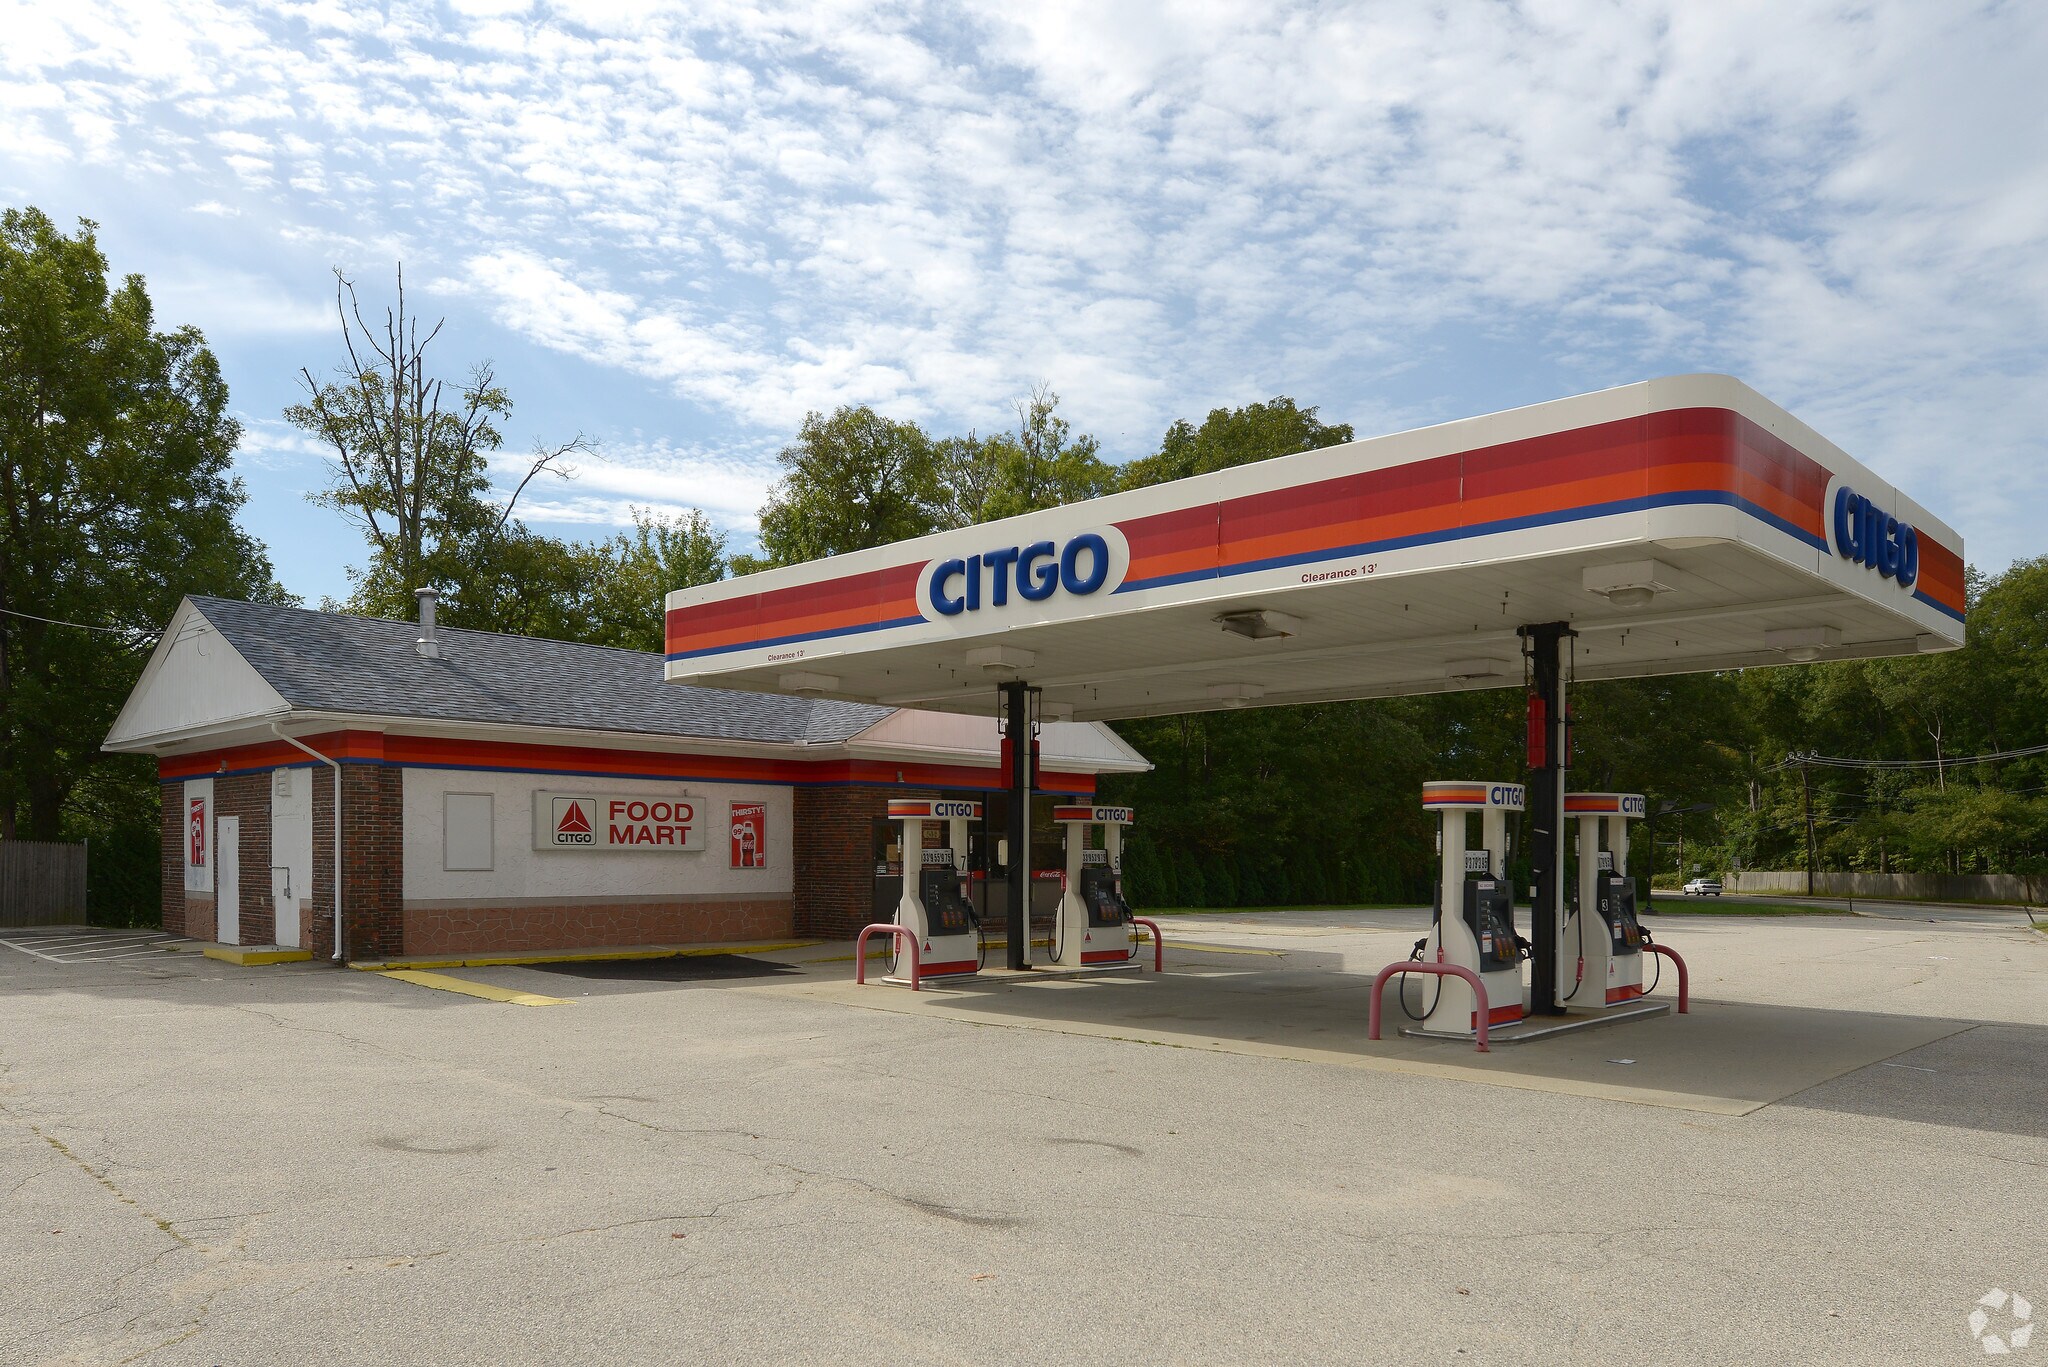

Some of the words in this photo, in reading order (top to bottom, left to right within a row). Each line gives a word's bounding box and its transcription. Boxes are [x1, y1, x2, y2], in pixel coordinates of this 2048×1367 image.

[1834, 485, 1918, 588] CITGO
[929, 533, 1109, 616] CITGO
[1301, 568, 1357, 583] Clearance
[767, 652, 796, 662] Clearance
[1491, 786, 1524, 806] CITGO
[609, 800, 694, 823] FOOD
[934, 802, 972, 817] CITGO
[1095, 808, 1127, 821] CITGO
[557, 833, 592, 843] CITGO
[609, 824, 692, 845] MART
[961, 855, 967, 871] 7
